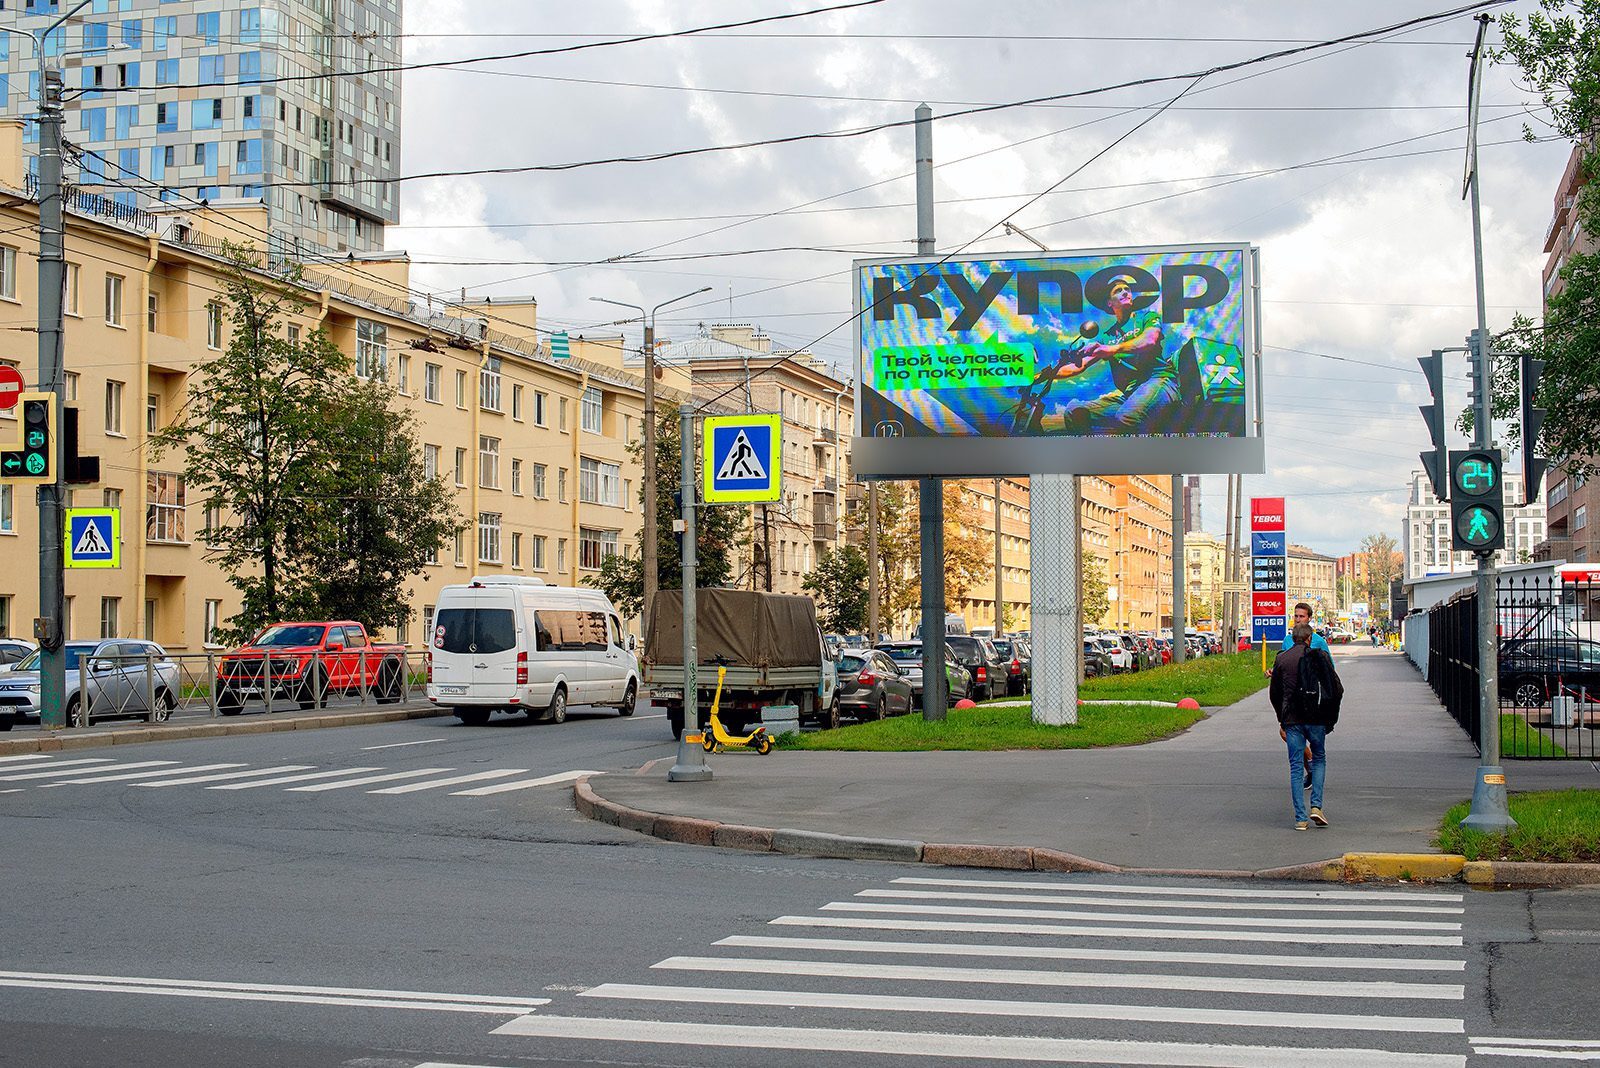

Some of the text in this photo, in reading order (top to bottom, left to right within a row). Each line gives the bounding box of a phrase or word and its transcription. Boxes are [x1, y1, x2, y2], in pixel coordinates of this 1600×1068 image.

[881, 352, 1024, 368] Твой человек
[885, 366, 1024, 380] по покупкам
[28, 431, 45, 446] 24
[1463, 462, 1492, 489] 24
[1253, 515, 1282, 523] TEBOIL
[1587, 572, 1600, 580] TE
